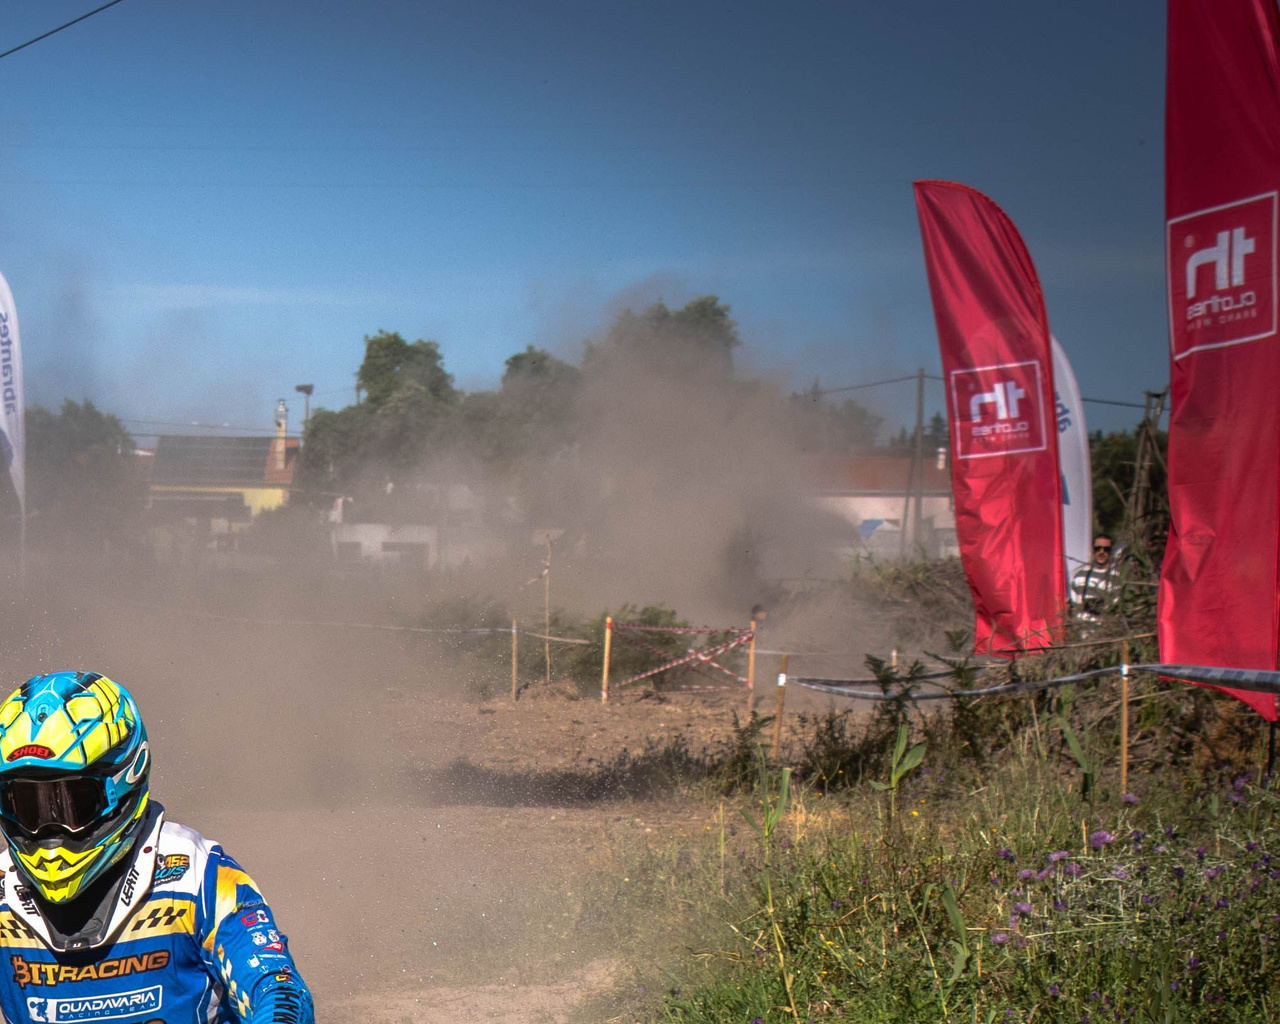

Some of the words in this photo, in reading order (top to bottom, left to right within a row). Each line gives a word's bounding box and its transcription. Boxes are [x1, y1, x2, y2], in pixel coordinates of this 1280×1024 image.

[12, 746, 50, 760] SHOEI
[59, 991, 156, 1015] QUADAVARIA
[59, 1009, 111, 1019] RACING
[119, 1003, 156, 1013] TEAM
